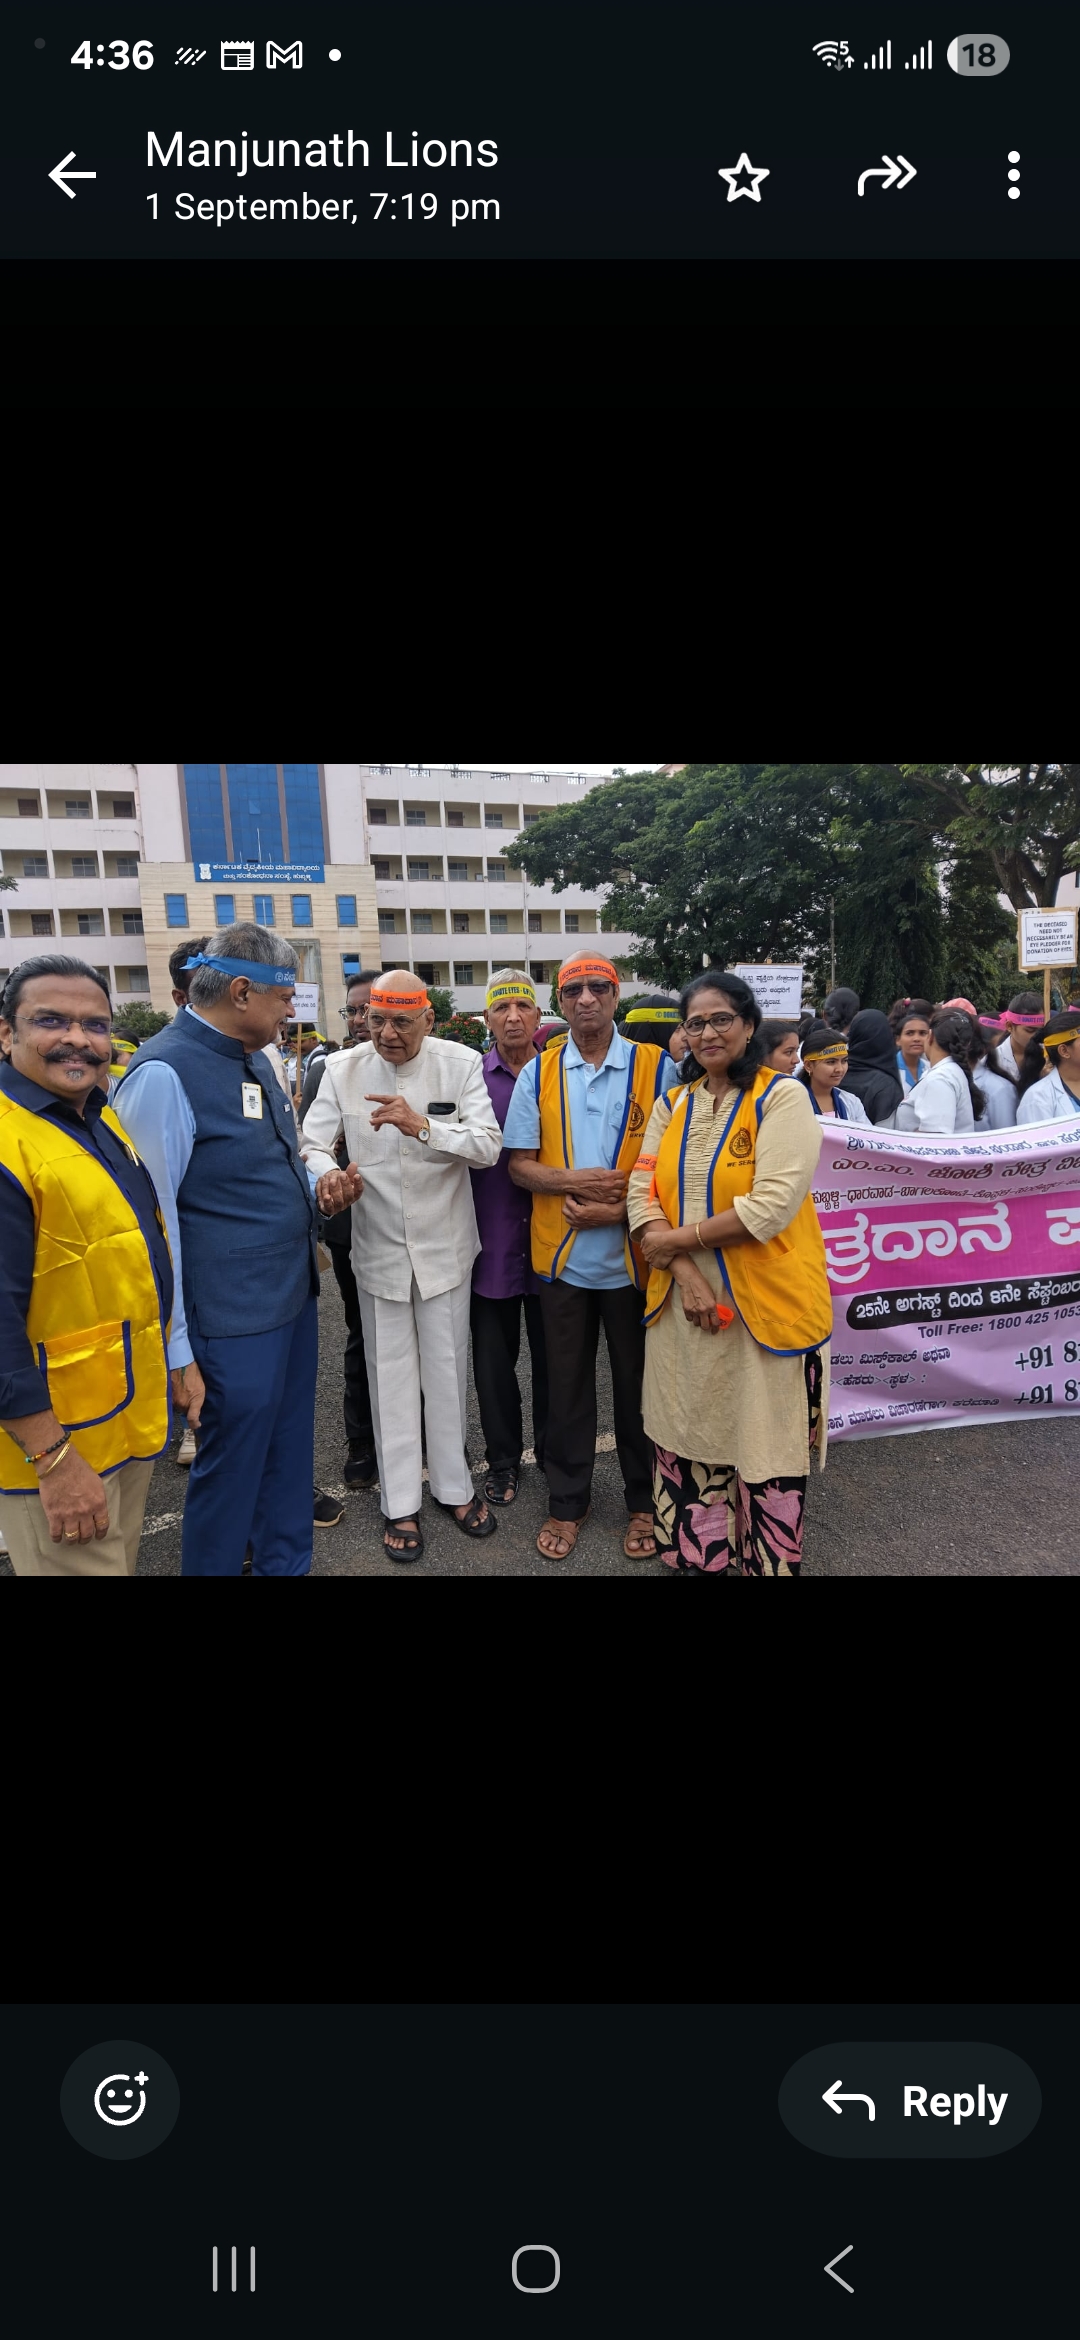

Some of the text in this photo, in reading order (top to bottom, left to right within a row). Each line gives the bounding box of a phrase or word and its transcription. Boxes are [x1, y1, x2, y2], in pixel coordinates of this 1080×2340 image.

[71, 40, 154, 70] 4:36
[962, 43, 996, 67] 18
[148, 130, 498, 177] Manjunath Lions
[147, 192, 499, 227] 1 September, 7:19 pm
[847, 1135, 864, 1151] ಶ್ರೀ
[1001, 1158, 1052, 1178] ನೇತ್ರ
[856, 1296, 890, 1318] 25ನೇ
[948, 1287, 983, 1308] ದಿಂದ
[990, 1283, 1021, 1304] 8ನೇ
[918, 1325, 942, 1338] Toll
[947, 1323, 983, 1335] Free:
[988, 1316, 1021, 1330] 1800
[1025, 1312, 1049, 1325] 425
[922, 1346, 950, 1363] ಅಥವಾ
[1015, 1341, 1080, 1371] +91 8
[1014, 1379, 1080, 1405] +91 8
[848, 1407, 885, 1426] ಮಾಡಲು
[904, 2084, 1008, 2125] Reply
